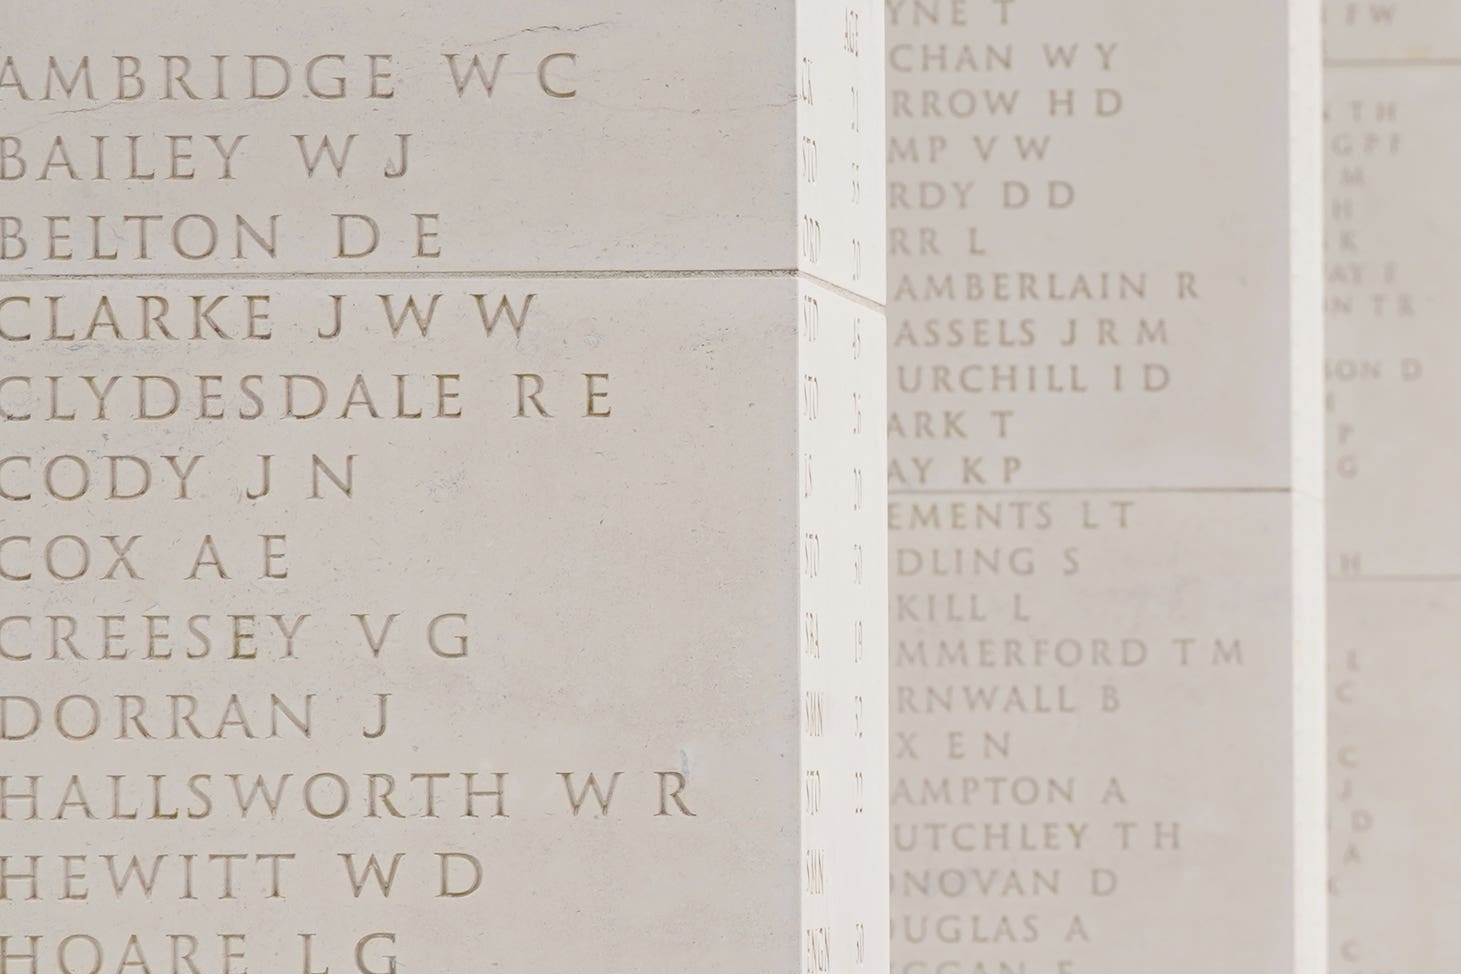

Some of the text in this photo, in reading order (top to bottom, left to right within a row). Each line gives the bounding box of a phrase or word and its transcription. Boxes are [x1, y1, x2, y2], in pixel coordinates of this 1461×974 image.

[1042, 42, 1079, 69] W
[1094, 42, 1118, 72] Y
[0, 52, 577, 101] AMBRIDGE W C
[1047, 88, 1075, 118] H
[1094, 88, 1124, 118] D
[0, 134, 412, 181] BAILEY W J
[972, 134, 998, 164] V
[1015, 134, 1051, 161] W
[1002, 180, 1031, 210] D
[1047, 180, 1076, 210] D
[0, 213, 441, 261] BELTON D E
[1176, 270, 1200, 301] R
[0, 293, 537, 342] CLARKE J W W
[1059, 317, 1078, 347] J
[1097, 317, 1120, 347] R
[1136, 317, 1169, 346] M
[1113, 363, 1124, 393] I
[1141, 362, 1171, 393] D
[0, 373, 611, 422] CLYDESDALE R E
[989, 409, 1015, 439] T
[0, 454, 357, 502] CODY J N
[1081, 501, 1098, 530] L
[1110, 500, 1136, 530] T
[0, 534, 288, 581] COX A E
[1063, 546, 1080, 577] S
[1013, 593, 1031, 623] L
[0, 613, 468, 661] CREESEY V G
[1171, 638, 1196, 667] T
[1212, 638, 1244, 666] M
[1101, 684, 1120, 713] B
[0, 693, 392, 741] DORRAN J
[0, 771, 697, 820] HALLSWORTH W R
[1101, 776, 1127, 805] A
[1113, 821, 1138, 850] T
[1153, 821, 1181, 851] H
[0, 852, 483, 900] HEWITT W D
[1090, 867, 1118, 897] D
